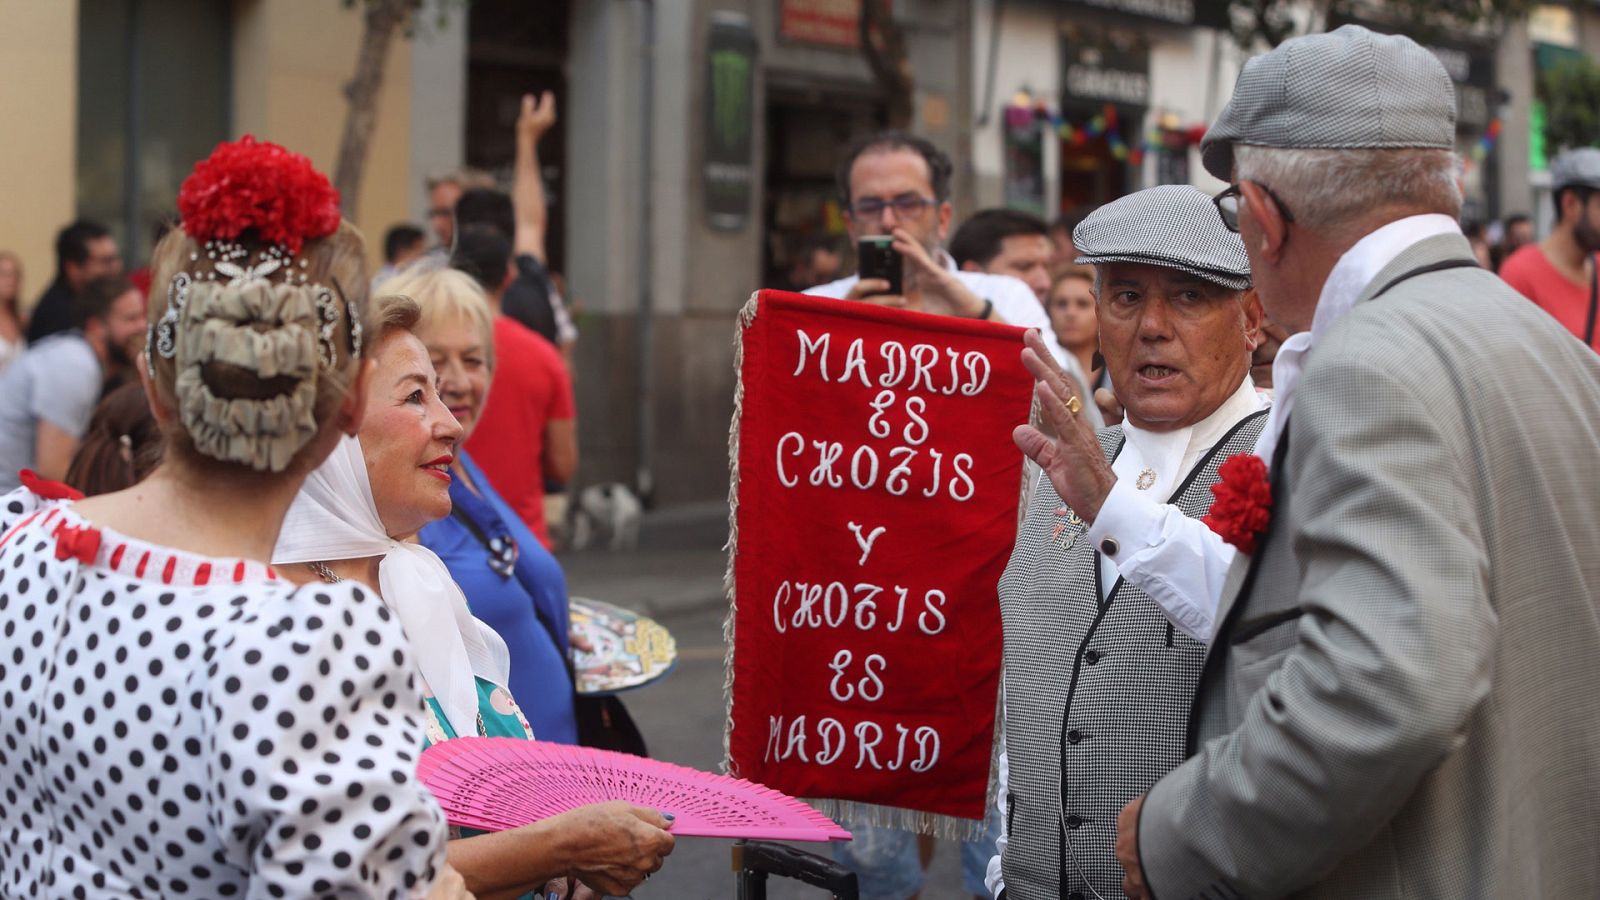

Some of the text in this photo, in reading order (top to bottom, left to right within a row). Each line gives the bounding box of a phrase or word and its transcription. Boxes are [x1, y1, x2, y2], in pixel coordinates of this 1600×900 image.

[794, 329, 991, 396] MADRID
[868, 390, 930, 445] ES
[847, 521, 886, 566] Y
[828, 649, 886, 701] ES
[764, 716, 941, 773] MADRID
